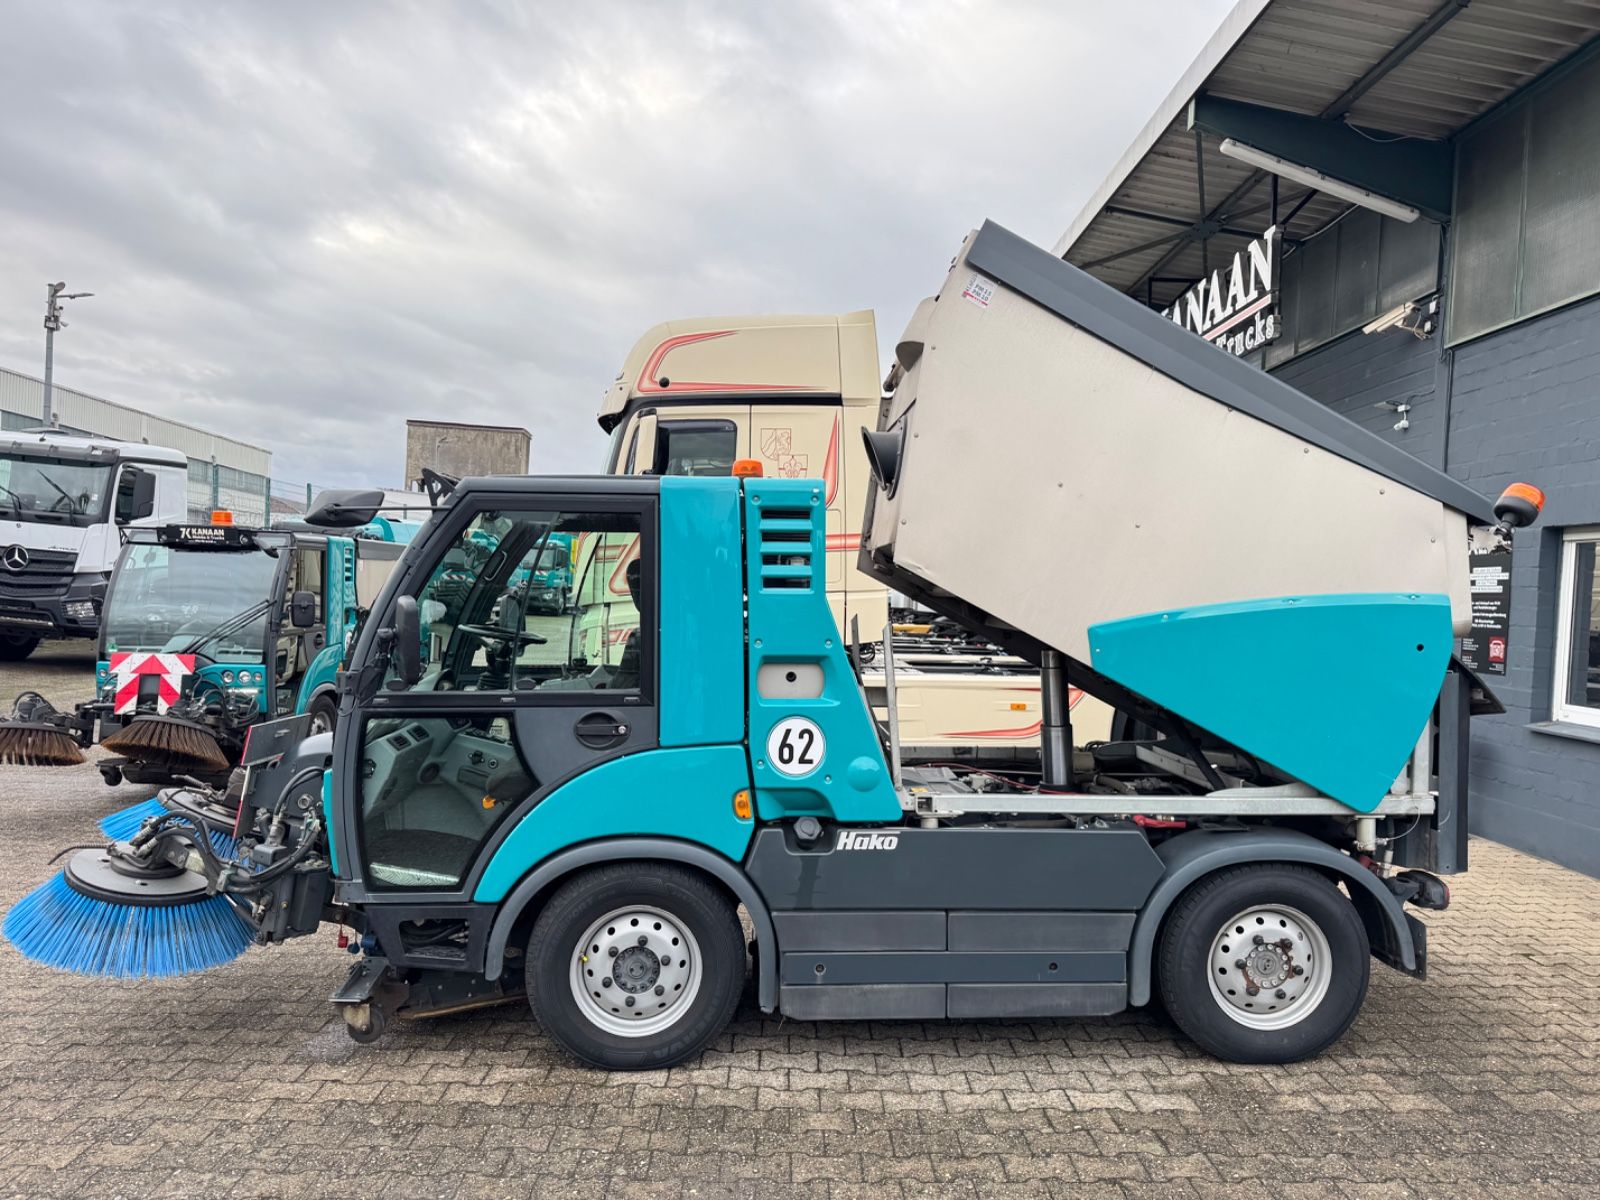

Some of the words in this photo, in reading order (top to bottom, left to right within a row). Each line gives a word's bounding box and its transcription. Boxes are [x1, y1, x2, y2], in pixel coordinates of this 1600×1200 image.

[191, 528, 225, 536] KANAAN
[778, 728, 814, 765] 62
[836, 831, 900, 850] Hako
